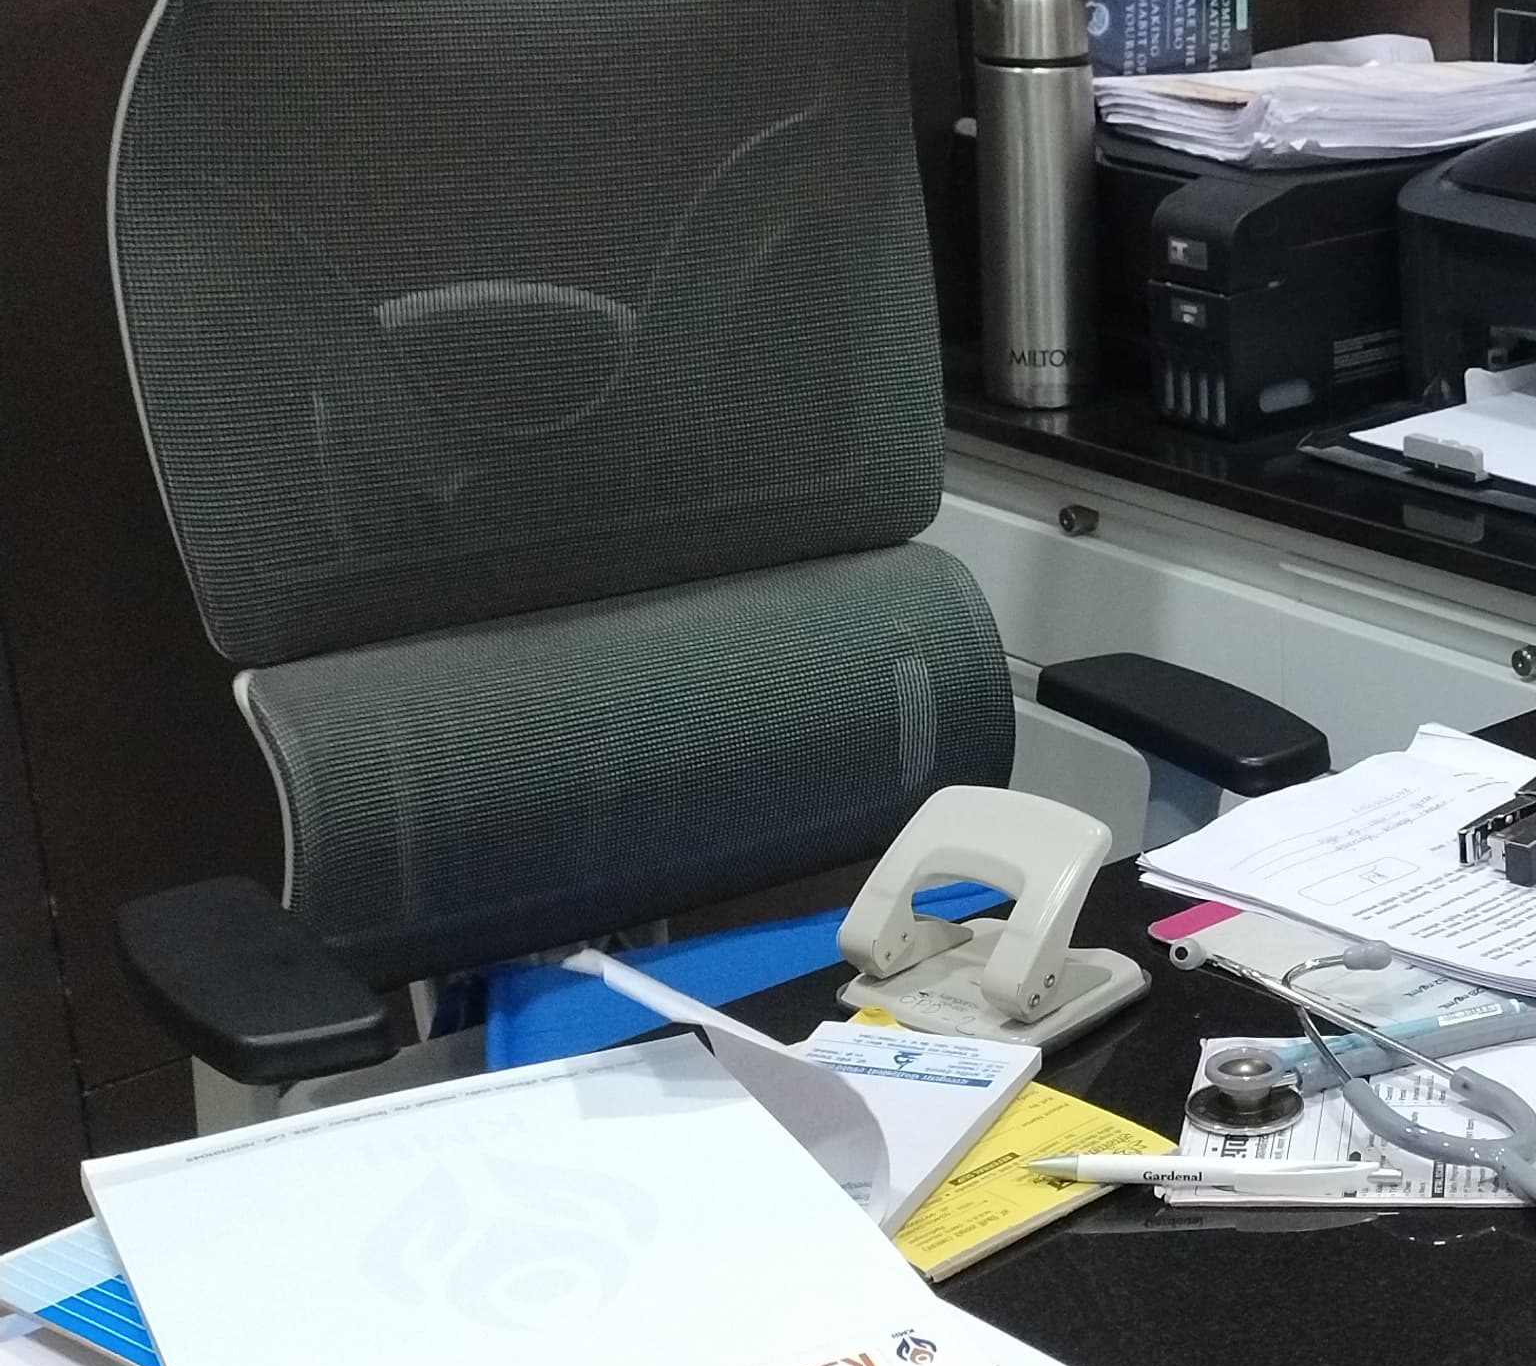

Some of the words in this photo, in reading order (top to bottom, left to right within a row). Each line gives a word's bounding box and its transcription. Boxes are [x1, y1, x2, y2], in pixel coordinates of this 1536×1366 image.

[1123, 2, 1136, 76] YOURSEL
[1185, 33, 1196, 67] THE
[1136, 51, 1148, 75] OF
[1143, 1170, 1203, 1182] Gardenal
